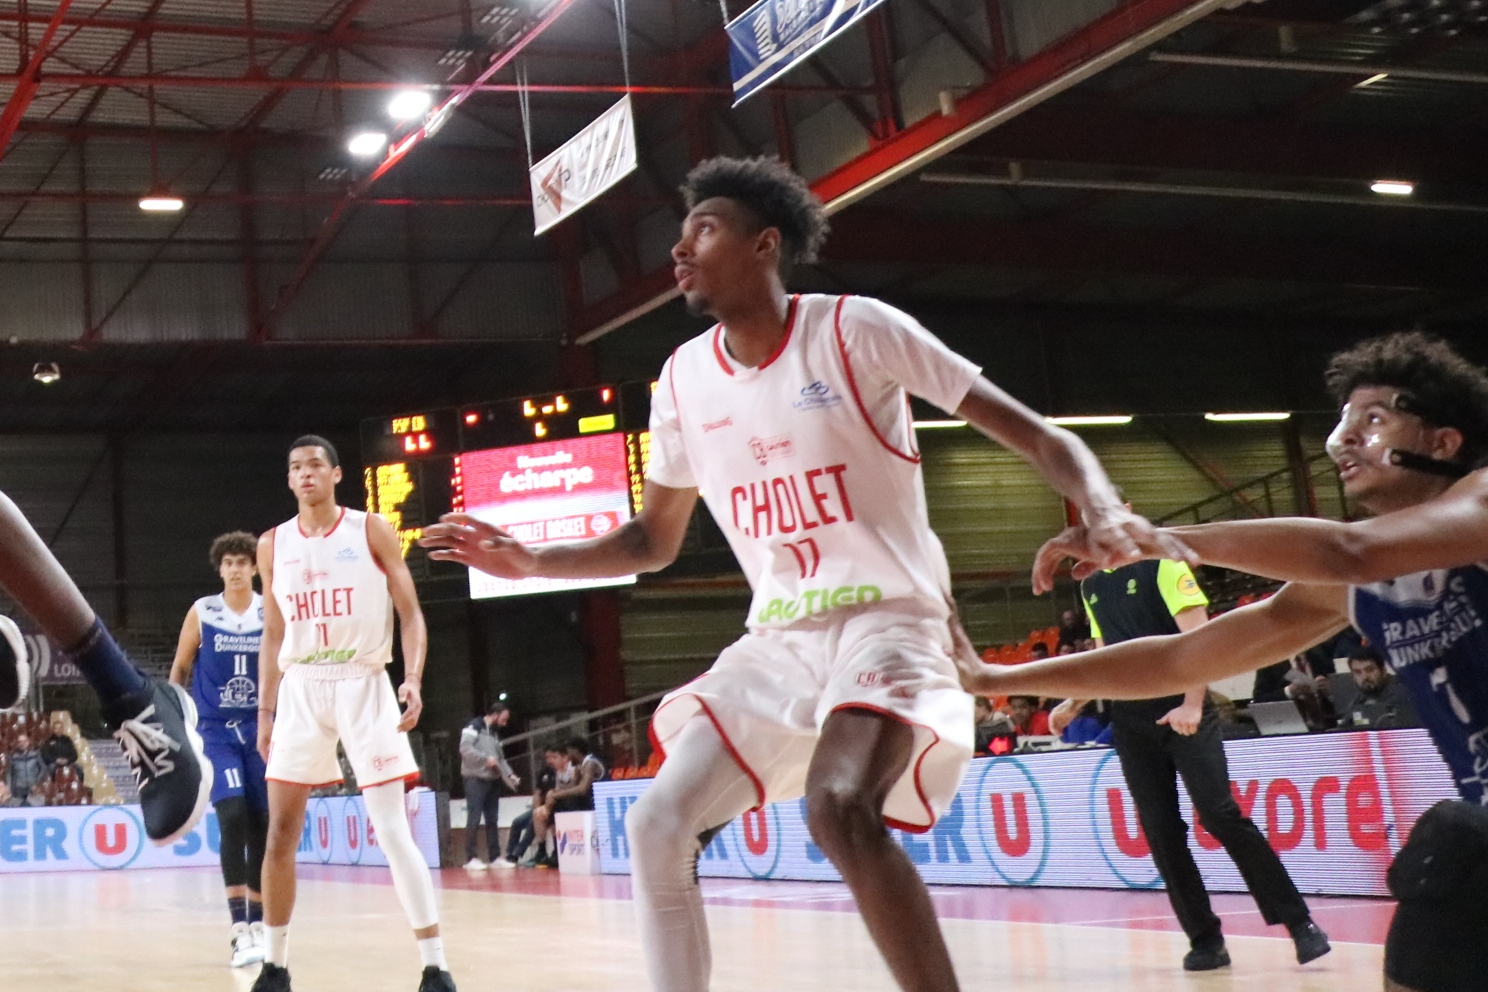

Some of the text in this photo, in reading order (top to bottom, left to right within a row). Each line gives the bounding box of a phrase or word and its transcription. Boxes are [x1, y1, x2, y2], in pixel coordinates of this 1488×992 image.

[499, 466, 593, 492] écharpe
[730, 464, 855, 539] CHOLET
[782, 537, 822, 581] 17
[234, 655, 247, 675] 11
[224, 768, 242, 789] 11
[94, 822, 128, 856] U
[990, 792, 1032, 857] U
